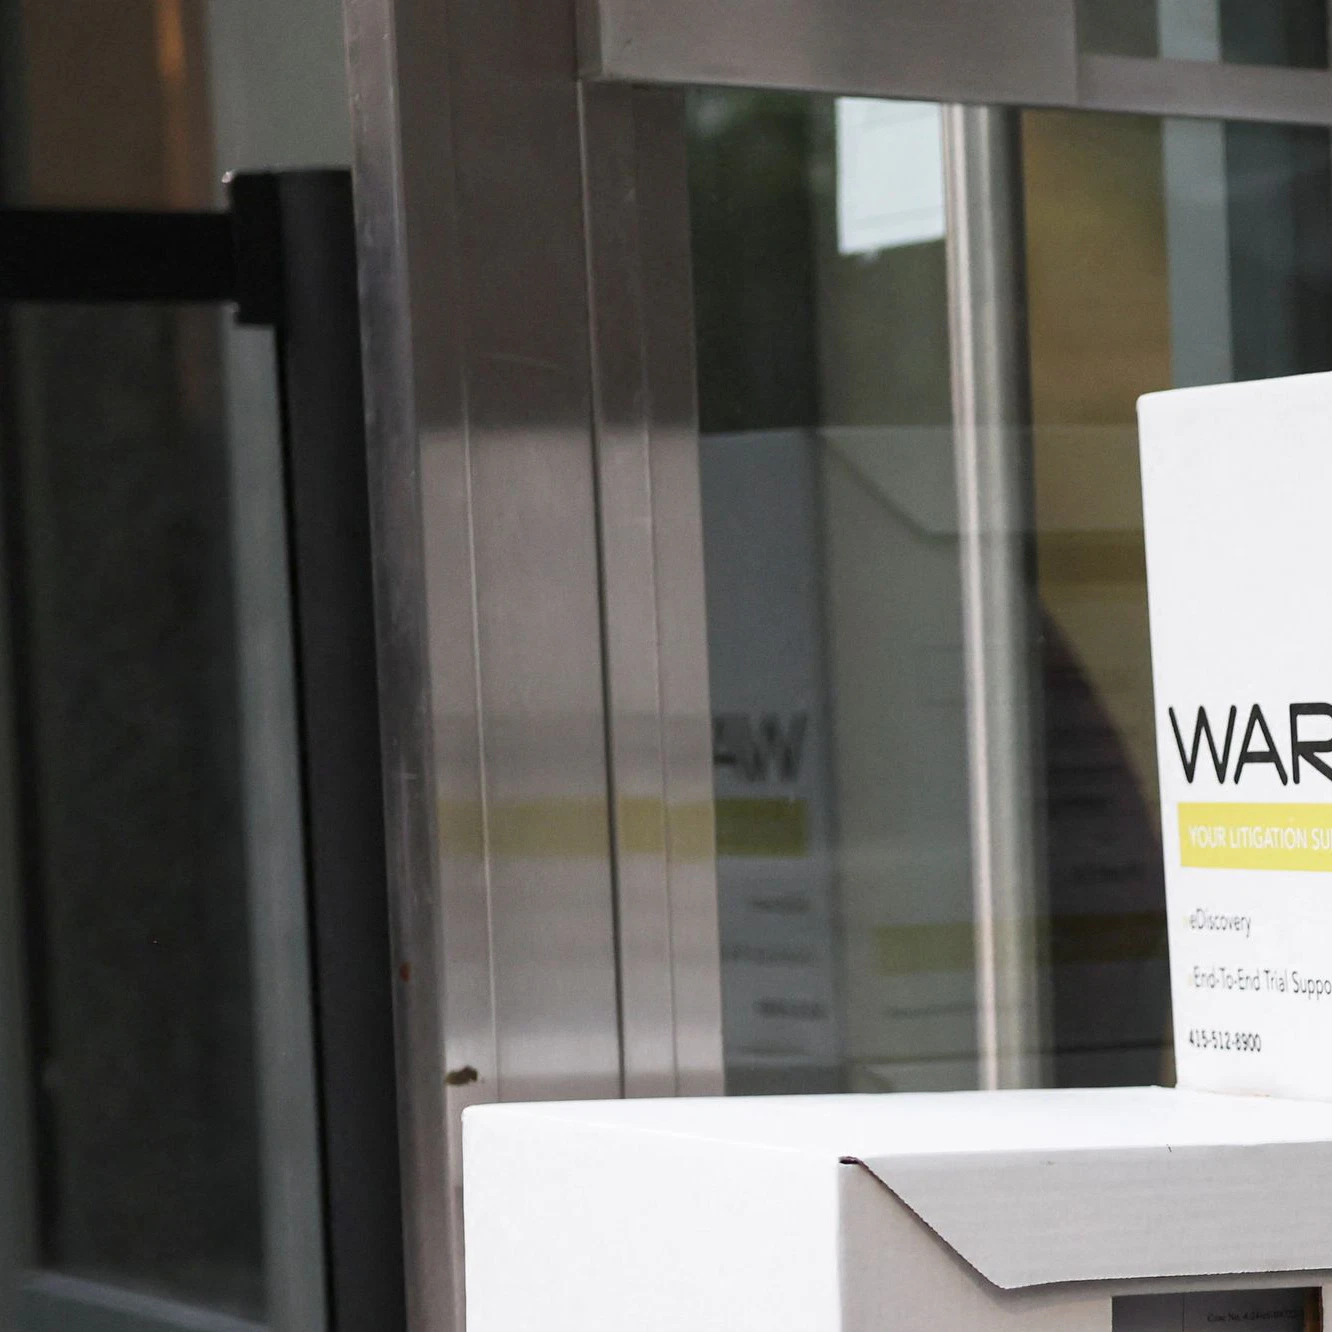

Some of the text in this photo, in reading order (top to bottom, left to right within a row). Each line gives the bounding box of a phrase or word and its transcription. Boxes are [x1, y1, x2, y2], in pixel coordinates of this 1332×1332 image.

[1188, 826, 1227, 848] YOUR
[1230, 826, 1308, 849] LITIGATION
[1189, 908, 1251, 938] eDiscovery
[1193, 965, 1261, 992] End-To-End
[1263, 969, 1288, 993] Trial
[1189, 1030, 1261, 1053] 415-512-8900
